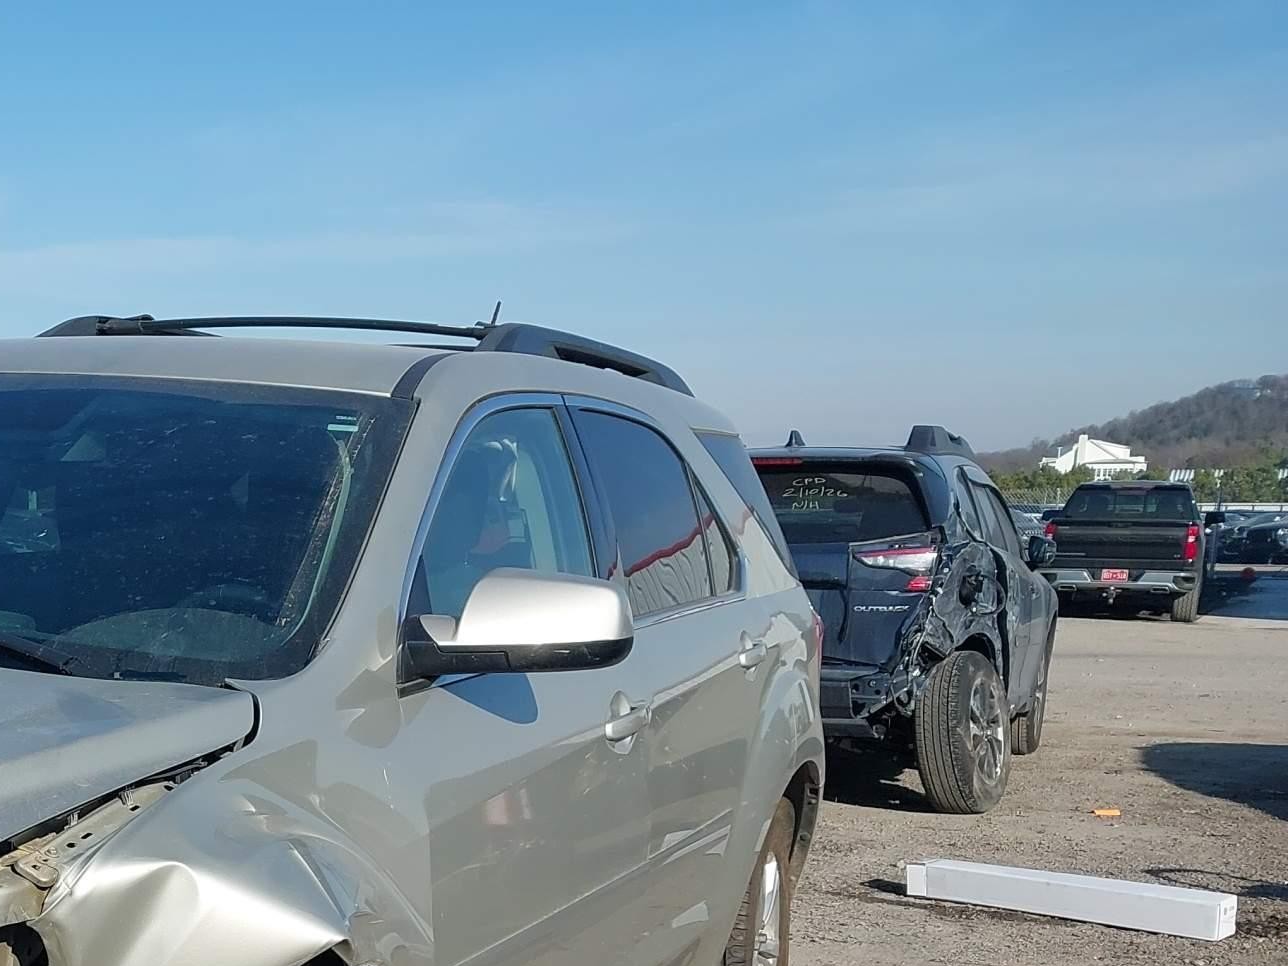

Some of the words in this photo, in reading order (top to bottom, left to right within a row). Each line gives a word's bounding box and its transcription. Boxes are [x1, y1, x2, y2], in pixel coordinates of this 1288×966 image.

[792, 477, 826, 486] CPD
[782, 486, 848, 498] 2/10/26
[792, 500, 820, 510] N/H
